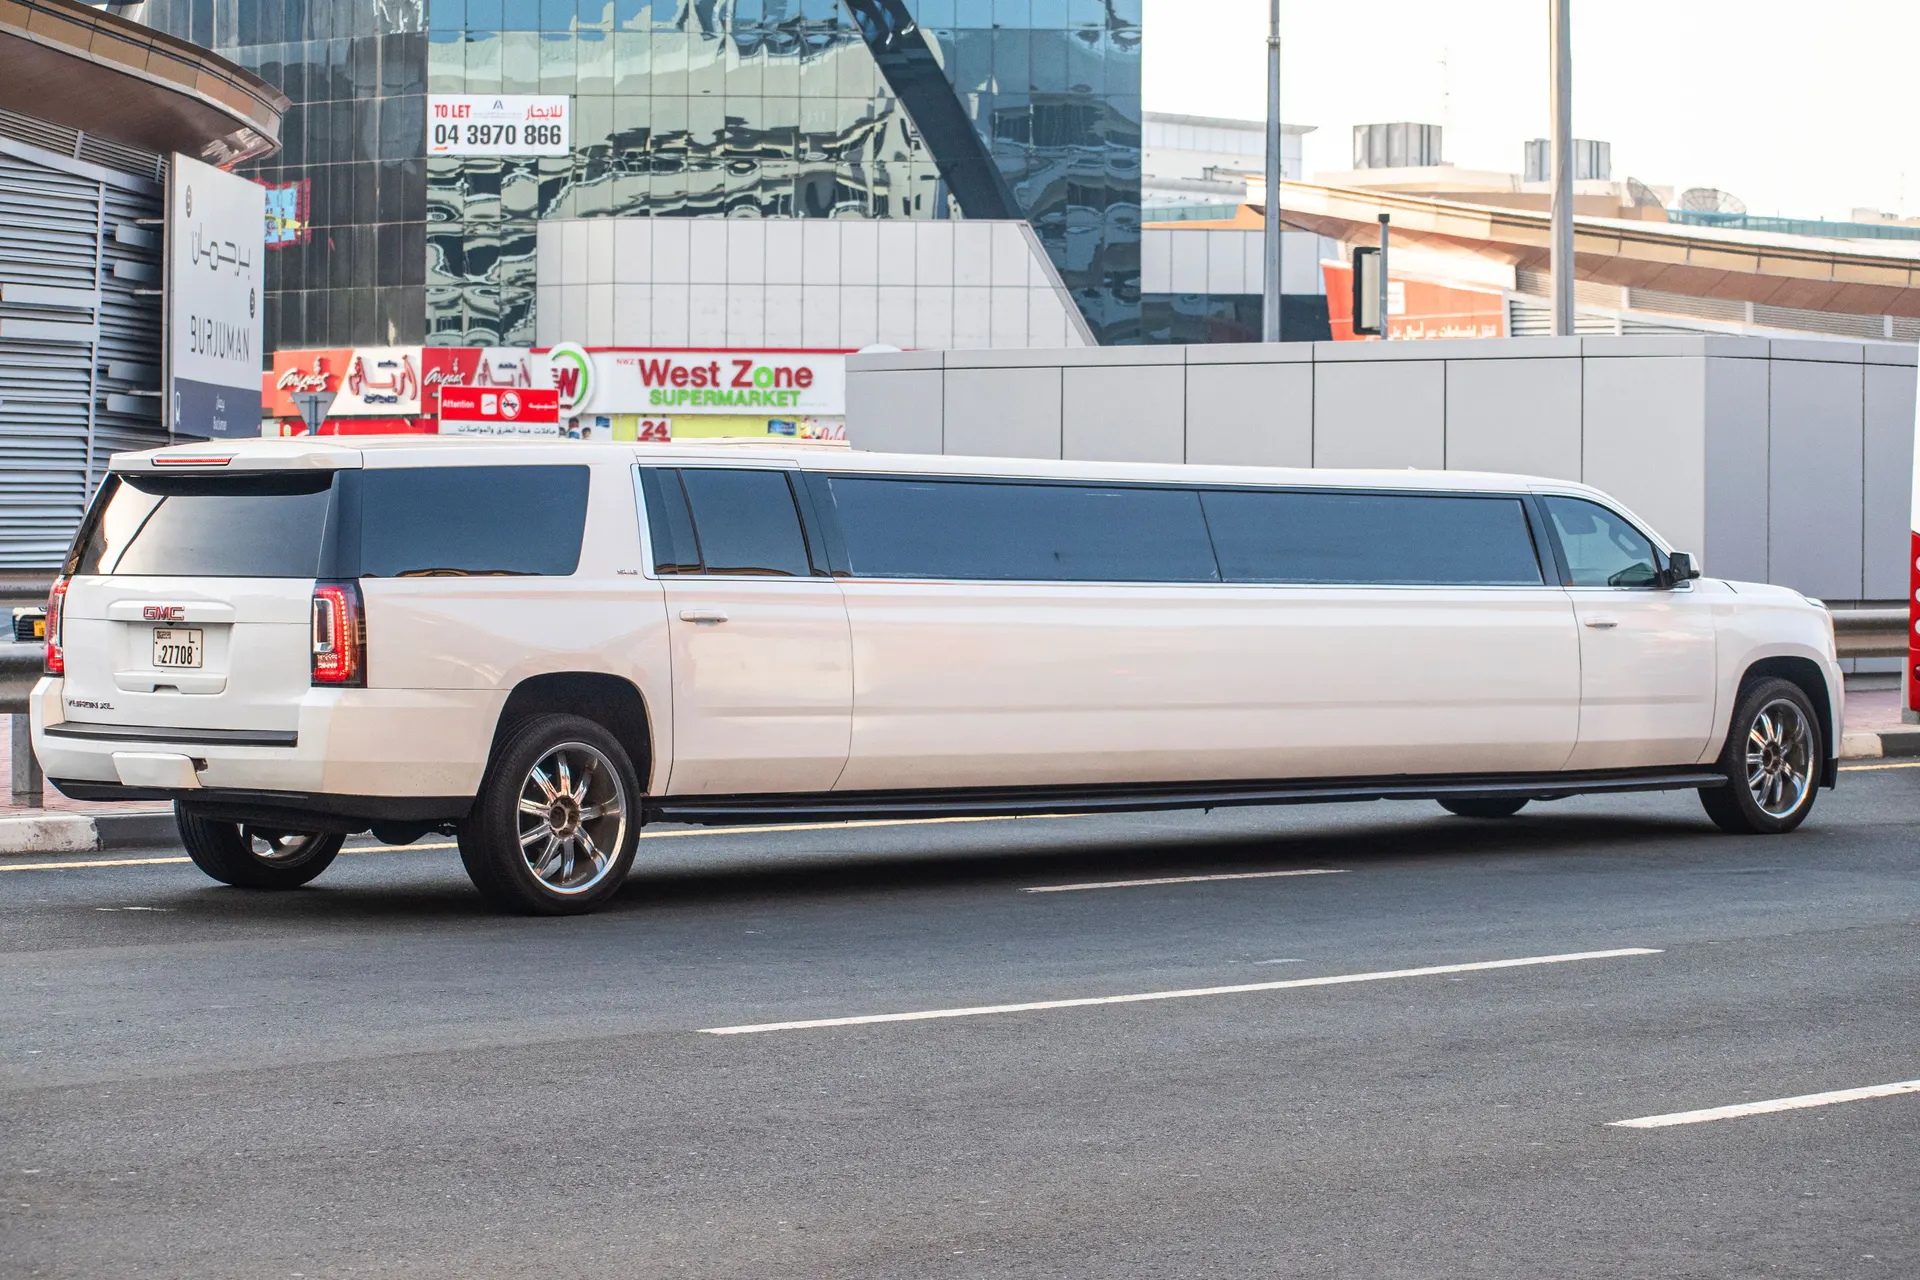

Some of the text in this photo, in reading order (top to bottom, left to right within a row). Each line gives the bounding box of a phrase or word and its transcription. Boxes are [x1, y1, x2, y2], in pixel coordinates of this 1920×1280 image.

[434, 104, 448, 118] TO
[451, 104, 471, 118] LET
[435, 124, 561, 145] 04 3970 866
[191, 222, 251, 281] برجمان
[190, 315, 250, 363] BURJUMAN
[638, 358, 813, 388] West Zone
[442, 399, 475, 409] Attention
[650, 389, 801, 407] SUPERMARKET
[641, 420, 668, 437] 24
[143, 606, 185, 621] GMC
[189, 632, 195, 643] L
[161, 645, 193, 665] 27708
